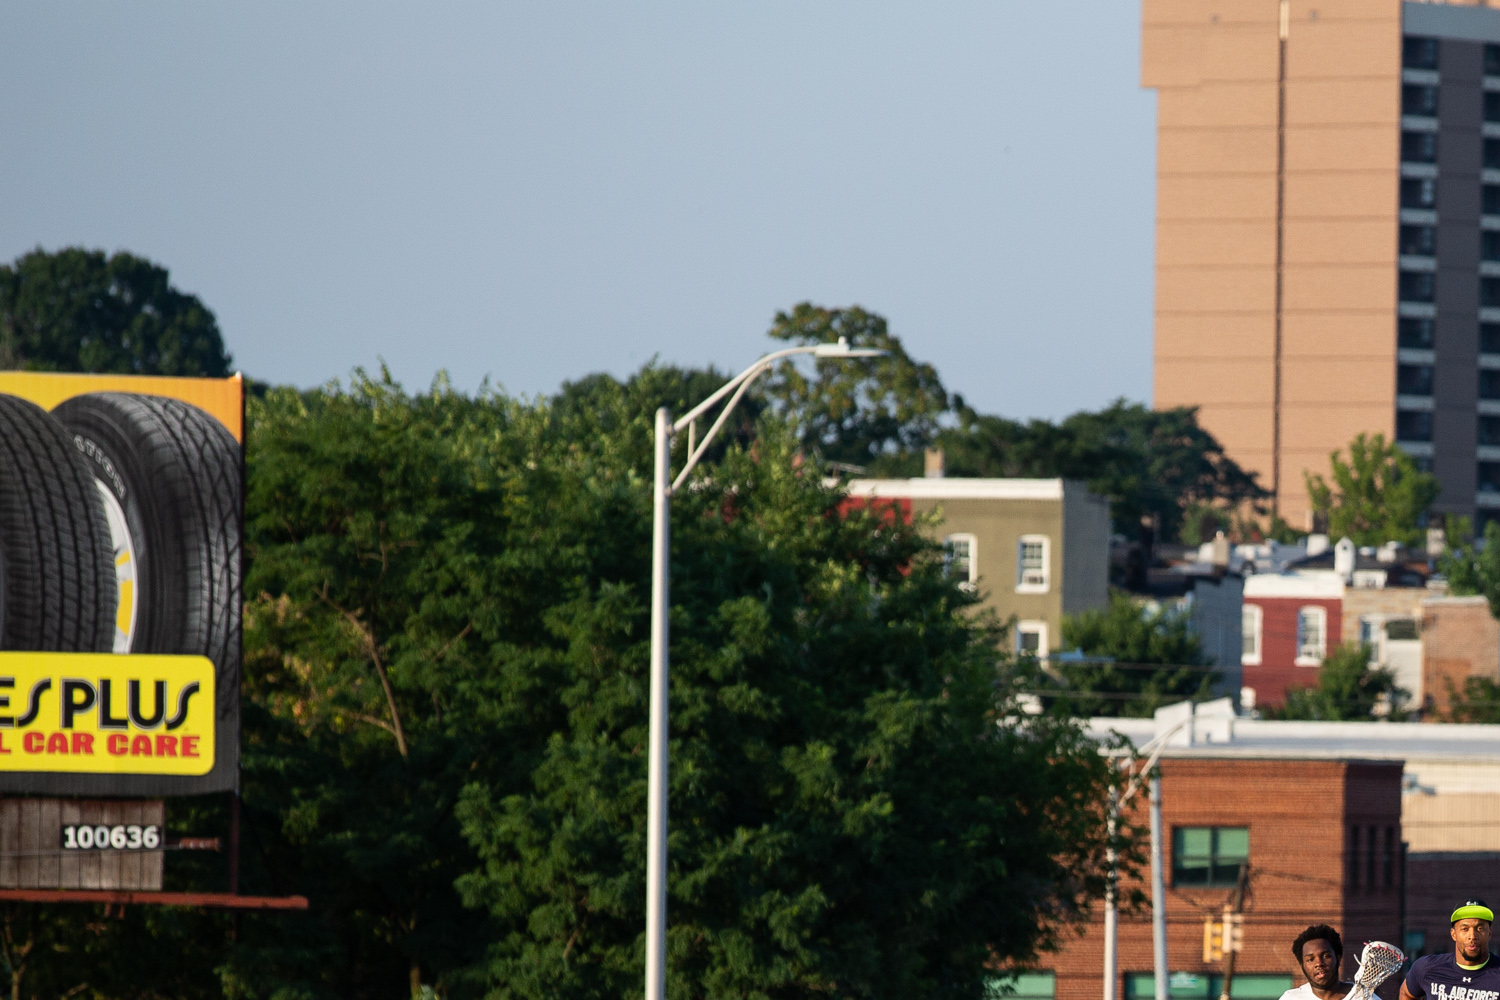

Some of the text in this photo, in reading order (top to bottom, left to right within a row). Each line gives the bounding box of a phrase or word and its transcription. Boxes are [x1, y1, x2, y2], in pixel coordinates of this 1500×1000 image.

[60, 677, 200, 732] PLUS
[23, 731, 95, 755] CAR
[107, 733, 200, 758] CARE
[64, 825, 160, 849] 100636
[1450, 985, 1467, 1000] AIR
